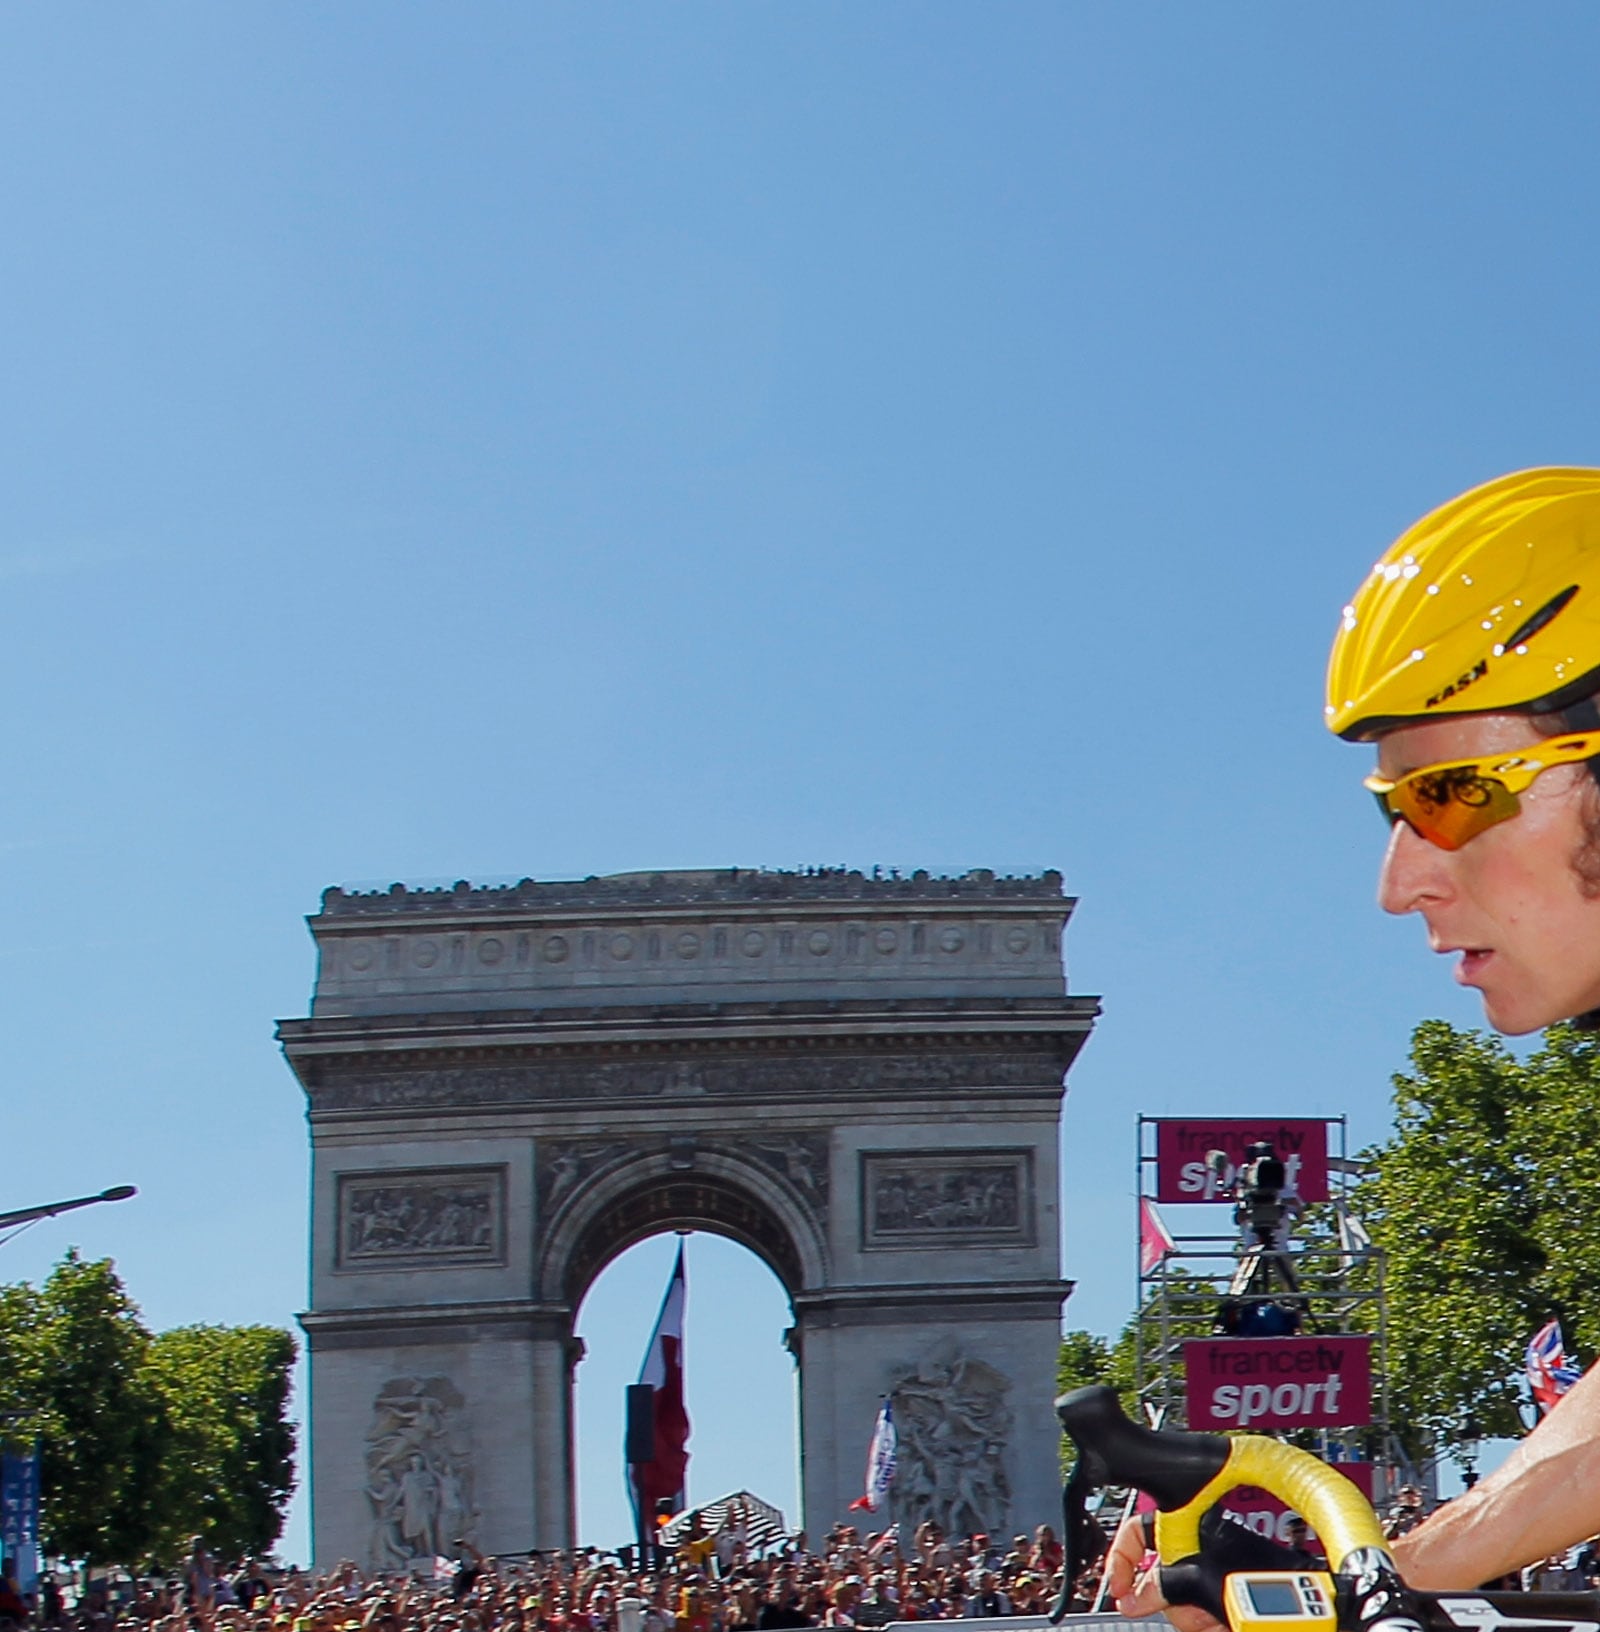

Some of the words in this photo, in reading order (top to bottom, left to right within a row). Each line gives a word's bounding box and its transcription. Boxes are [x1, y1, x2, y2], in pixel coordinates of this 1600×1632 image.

[1425, 659, 1488, 708] KASK
[1208, 1345, 1345, 1375] francetv
[1210, 1373, 1343, 1425] sport
